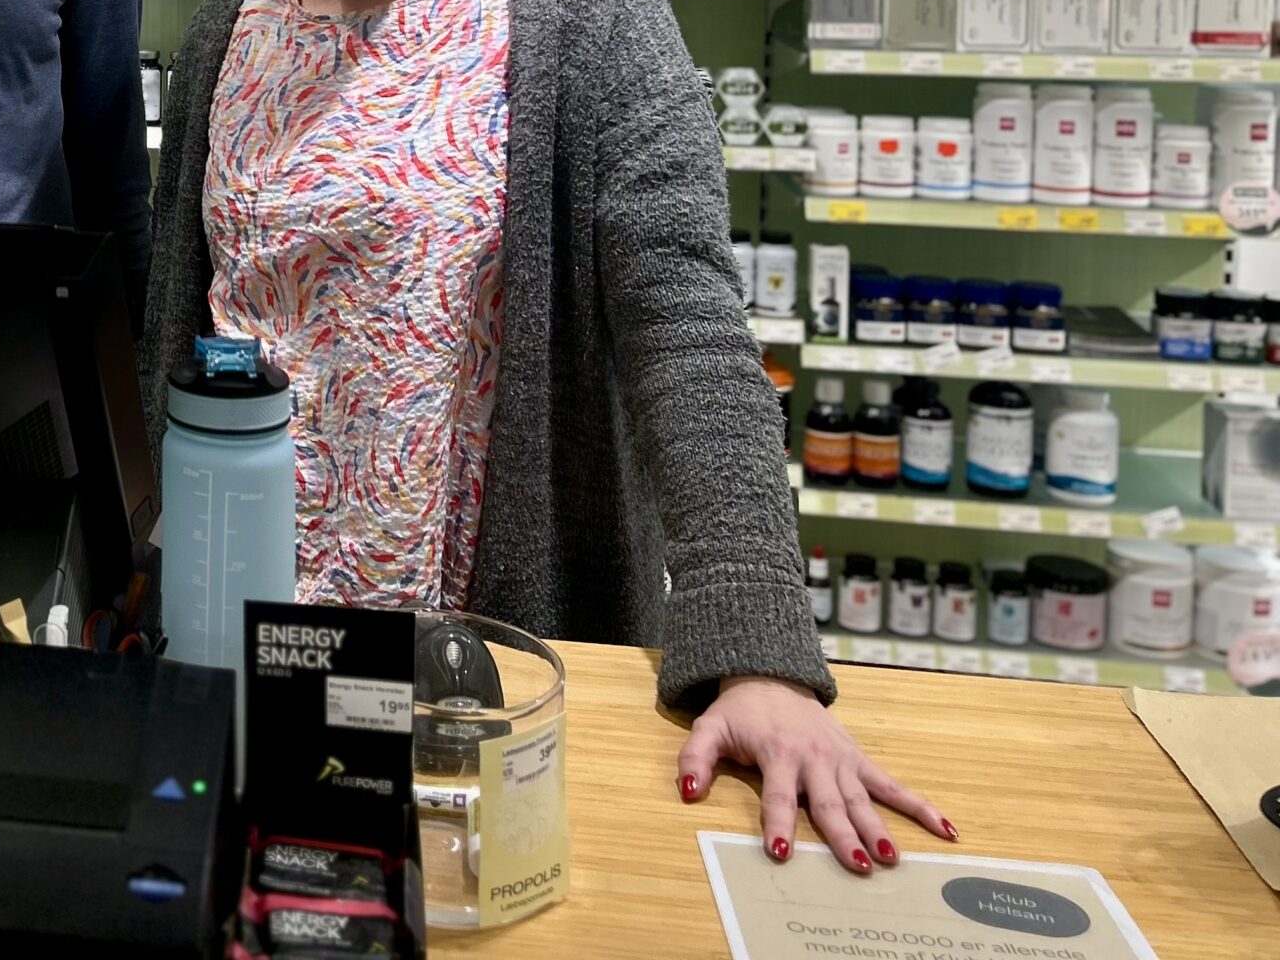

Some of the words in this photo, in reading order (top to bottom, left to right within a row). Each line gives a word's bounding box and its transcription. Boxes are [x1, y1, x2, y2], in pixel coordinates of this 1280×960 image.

[257, 623, 347, 649] ENERGY
[257, 646, 333, 670] SNACK
[332, 776, 393, 791] PUREPOWER
[266, 854, 329, 871] SNACK
[490, 863, 562, 902] PROPOLIS
[992, 891, 1037, 908] Klub
[272, 909, 350, 928] ENERGY
[978, 901, 1055, 924] Helsam
[272, 922, 342, 940] SNACK
[786, 921, 843, 937] Over
[849, 927, 954, 949] 200.000
[960, 941, 986, 952] er
[991, 942, 1086, 960] allerede
[804, 942, 899, 960] medlem
